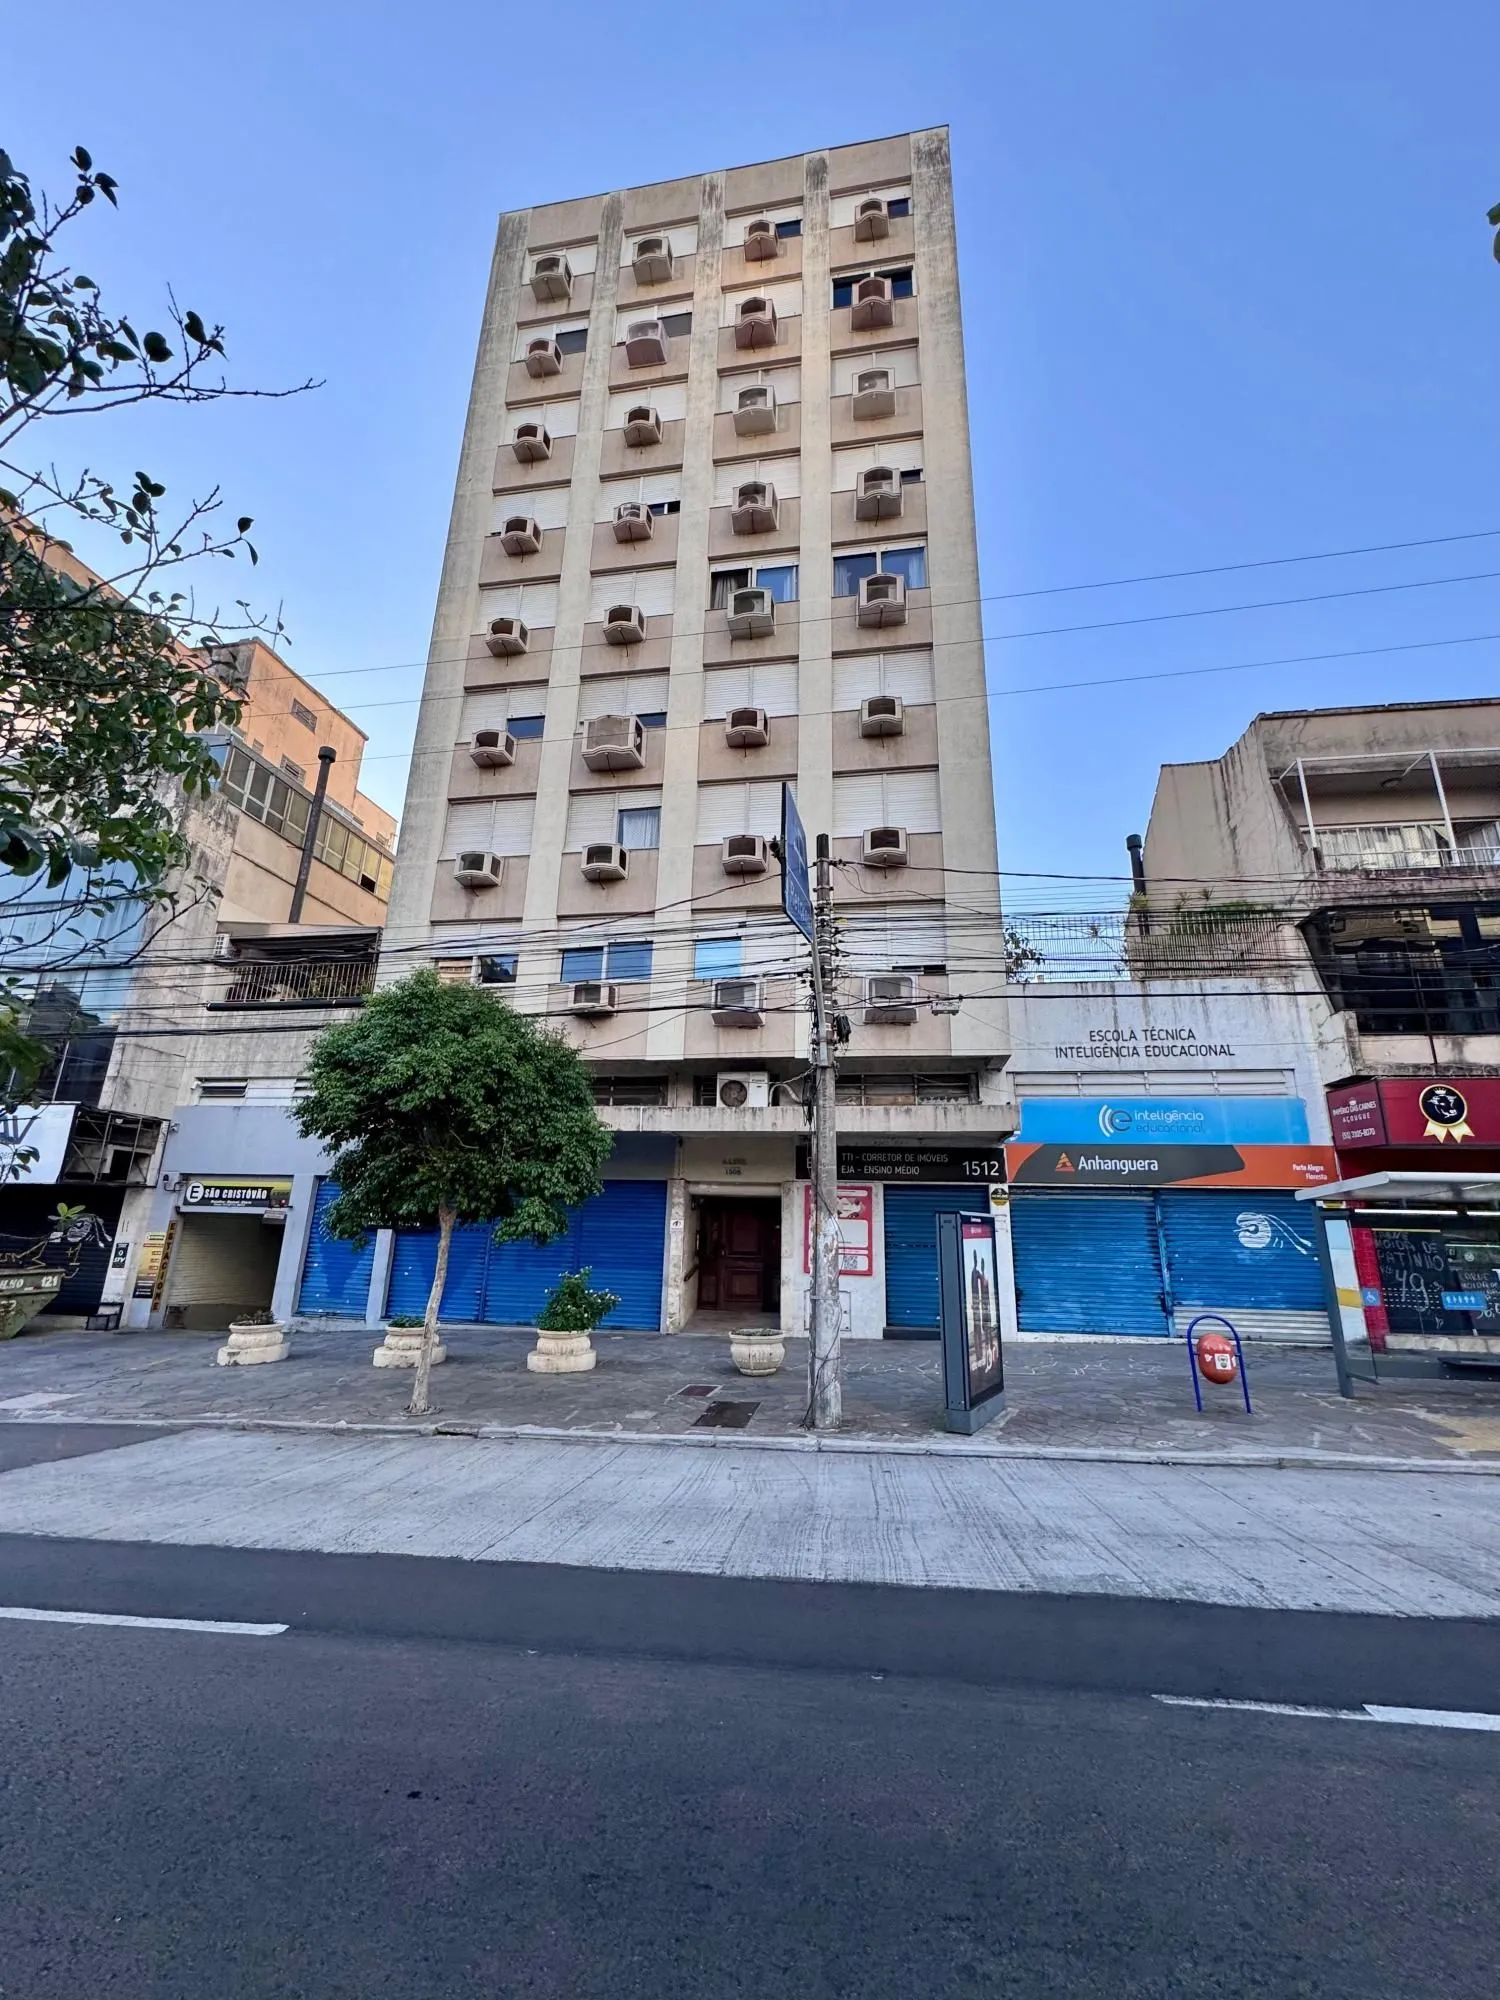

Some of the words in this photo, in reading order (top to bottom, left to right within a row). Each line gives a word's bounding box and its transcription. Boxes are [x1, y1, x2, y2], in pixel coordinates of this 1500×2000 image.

[1089, 1029, 1137, 1042] ESCOLA
[1142, 1027, 1196, 1041] TÉCNICA
[1055, 1043, 1140, 1059] INTELIGÊNCIA
[1144, 1044, 1236, 1057] EDUCACIONAL
[1134, 1110, 1204, 1123] inteligência
[1136, 1122, 1204, 1133] educacional
[862, 1153, 902, 1162] CORRETOR
[905, 1154, 915, 1162] DE
[917, 1152, 949, 1163] IMÓVEIS
[841, 1165, 855, 1174] EJA
[864, 1165, 892, 1174] ENSINO
[895, 1164, 920, 1175] MÉDIO
[962, 1161, 1000, 1176] 1512
[1078, 1155, 1159, 1174] Anhanguera
[204, 1187, 220, 1198] SÃO
[222, 1187, 268, 1200] CRISTÓVÃO
[152, 1222, 177, 1311] ESTACIONE
[41, 1275, 59, 1287] 121
